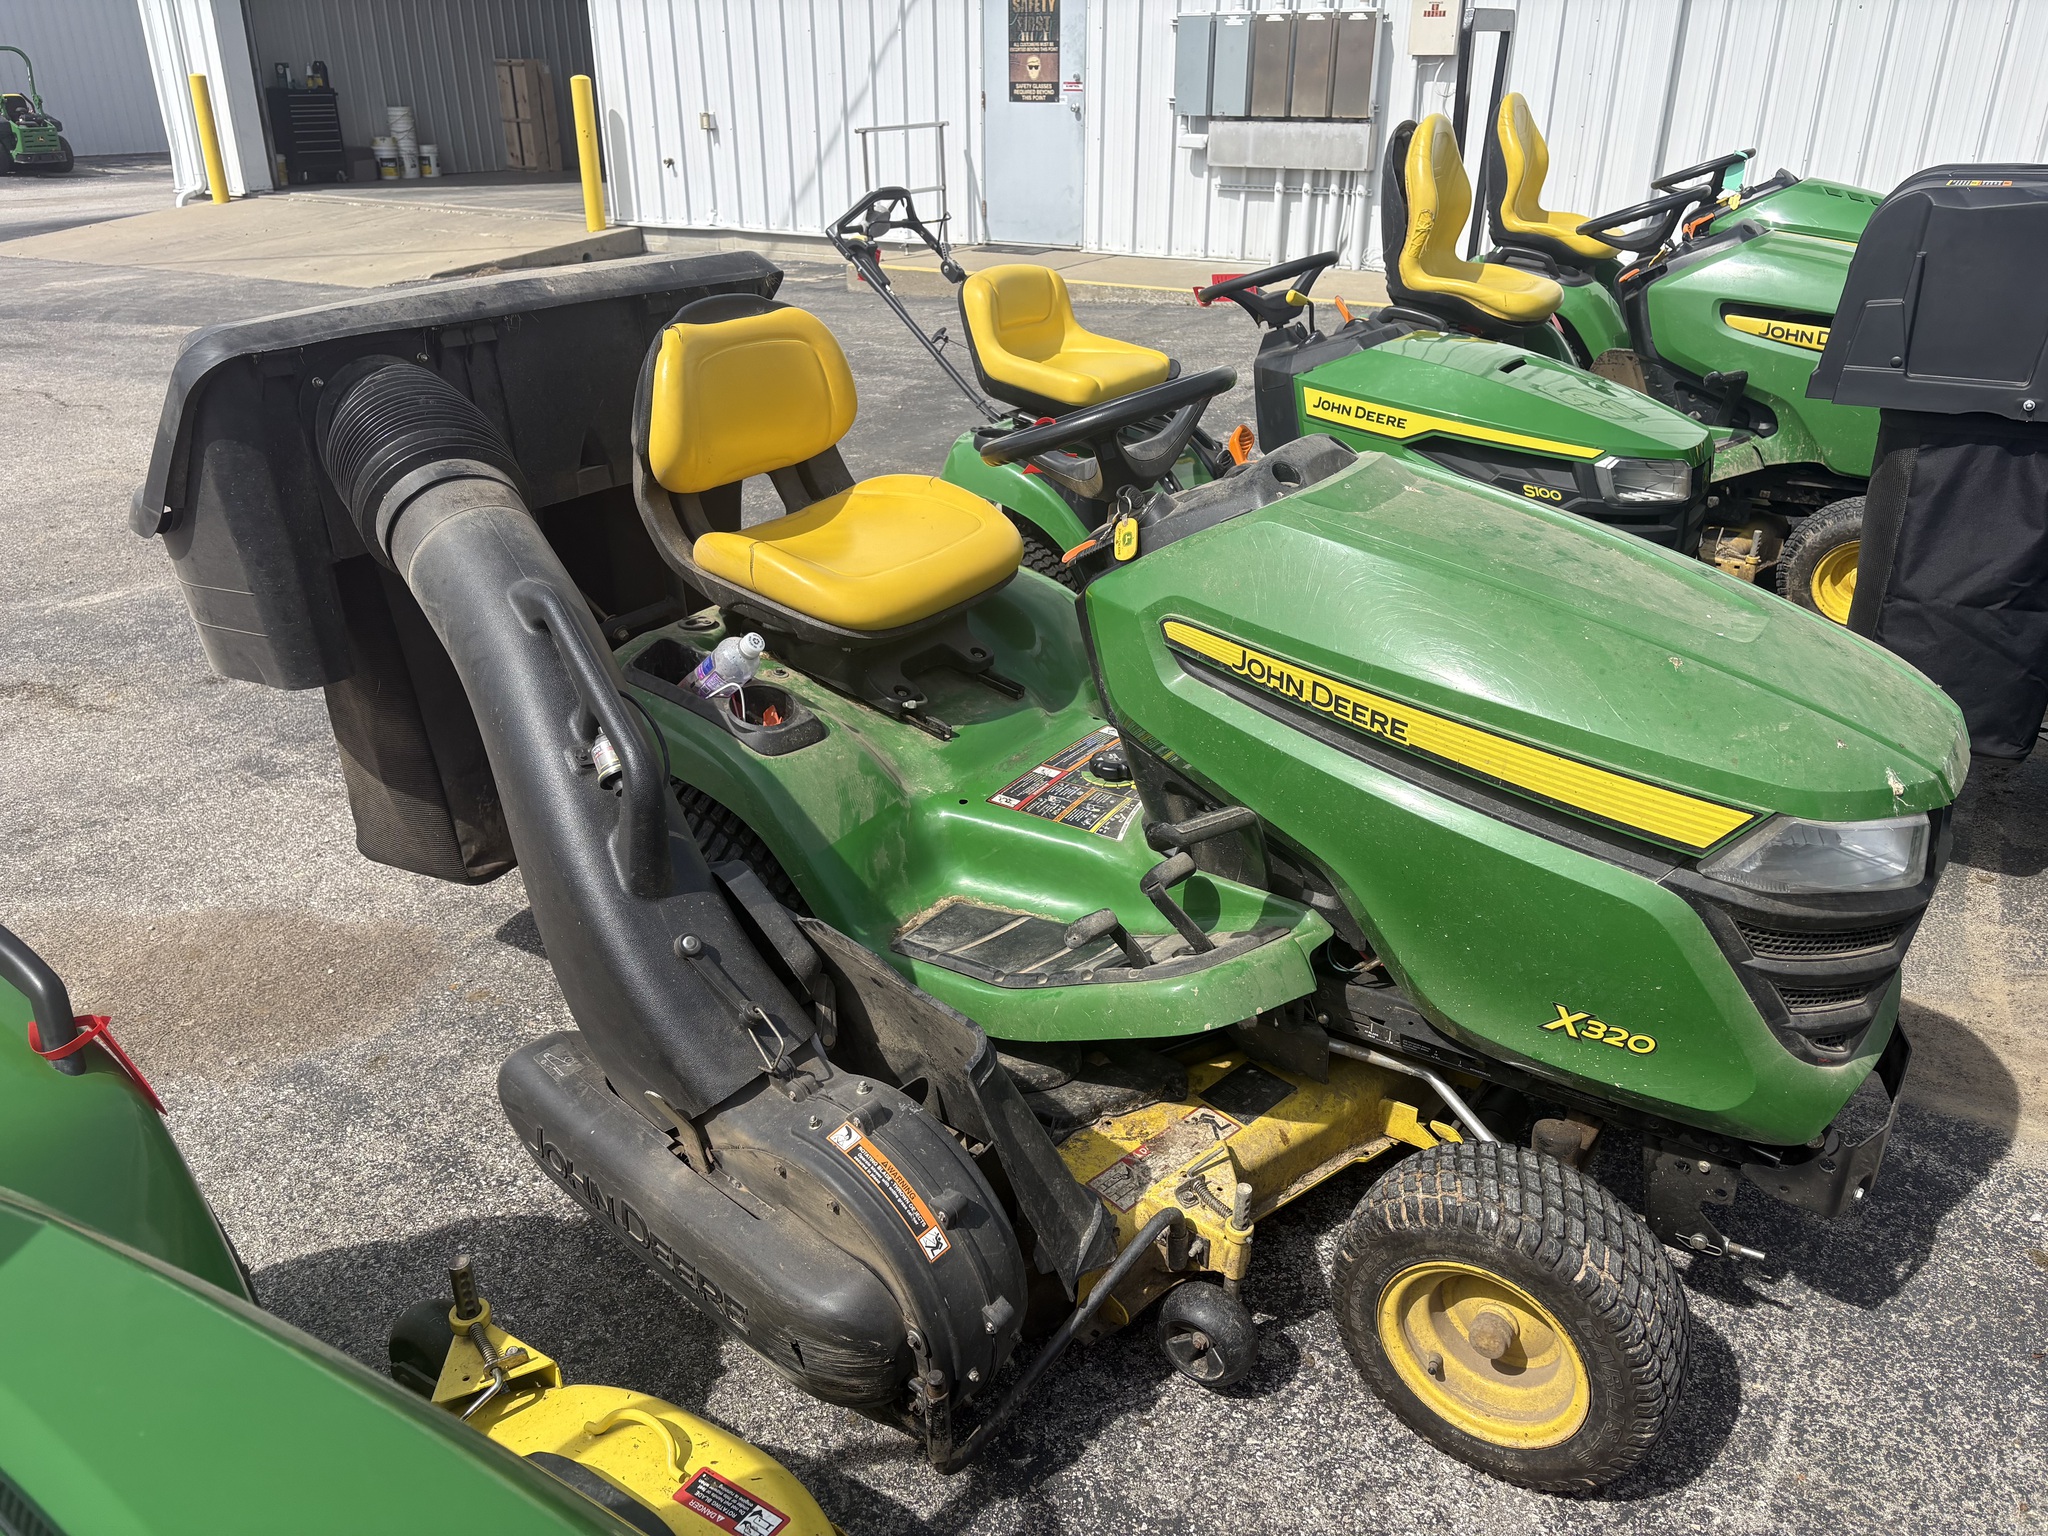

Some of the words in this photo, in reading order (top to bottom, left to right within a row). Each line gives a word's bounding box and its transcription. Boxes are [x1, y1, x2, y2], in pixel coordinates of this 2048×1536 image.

[1017, 15, 1051, 31] FIRST
[1758, 322, 1814, 344] JOHN
[1313, 396, 1352, 416] JOHN
[1355, 406, 1407, 429] DEERE
[1523, 484, 1562, 501] S100
[1232, 650, 1304, 698] JOHN
[1311, 680, 1409, 742] DEERE
[1538, 1002, 1657, 1054] X320
[858, 1146, 878, 1166] ROTATING
[876, 1164, 891, 1181] BLADE
[892, 1183, 911, 1204] THROWN
[858, 1152, 871, 1167] Operate
[882, 1178, 890, 1187] with
[889, 1186, 899, 1198] entire
[897, 1197, 908, 1210] grass
[886, 1165, 917, 1200] WARNING
[529, 1126, 616, 1225] JOHN
[621, 1200, 751, 1337] DEERE
[1575, 1317, 1626, 1469] CARLISLE
[693, 1490, 713, 1504] BLADE
[710, 1492, 724, 1503] hands
[723, 1499, 732, 1507] put
[731, 1504, 739, 1512] not
[738, 1495, 754, 1507] engine
[688, 1498, 718, 1520] DANGER
[712, 1500, 738, 1518] ROTATING
[738, 1508, 746, 1516] Do
